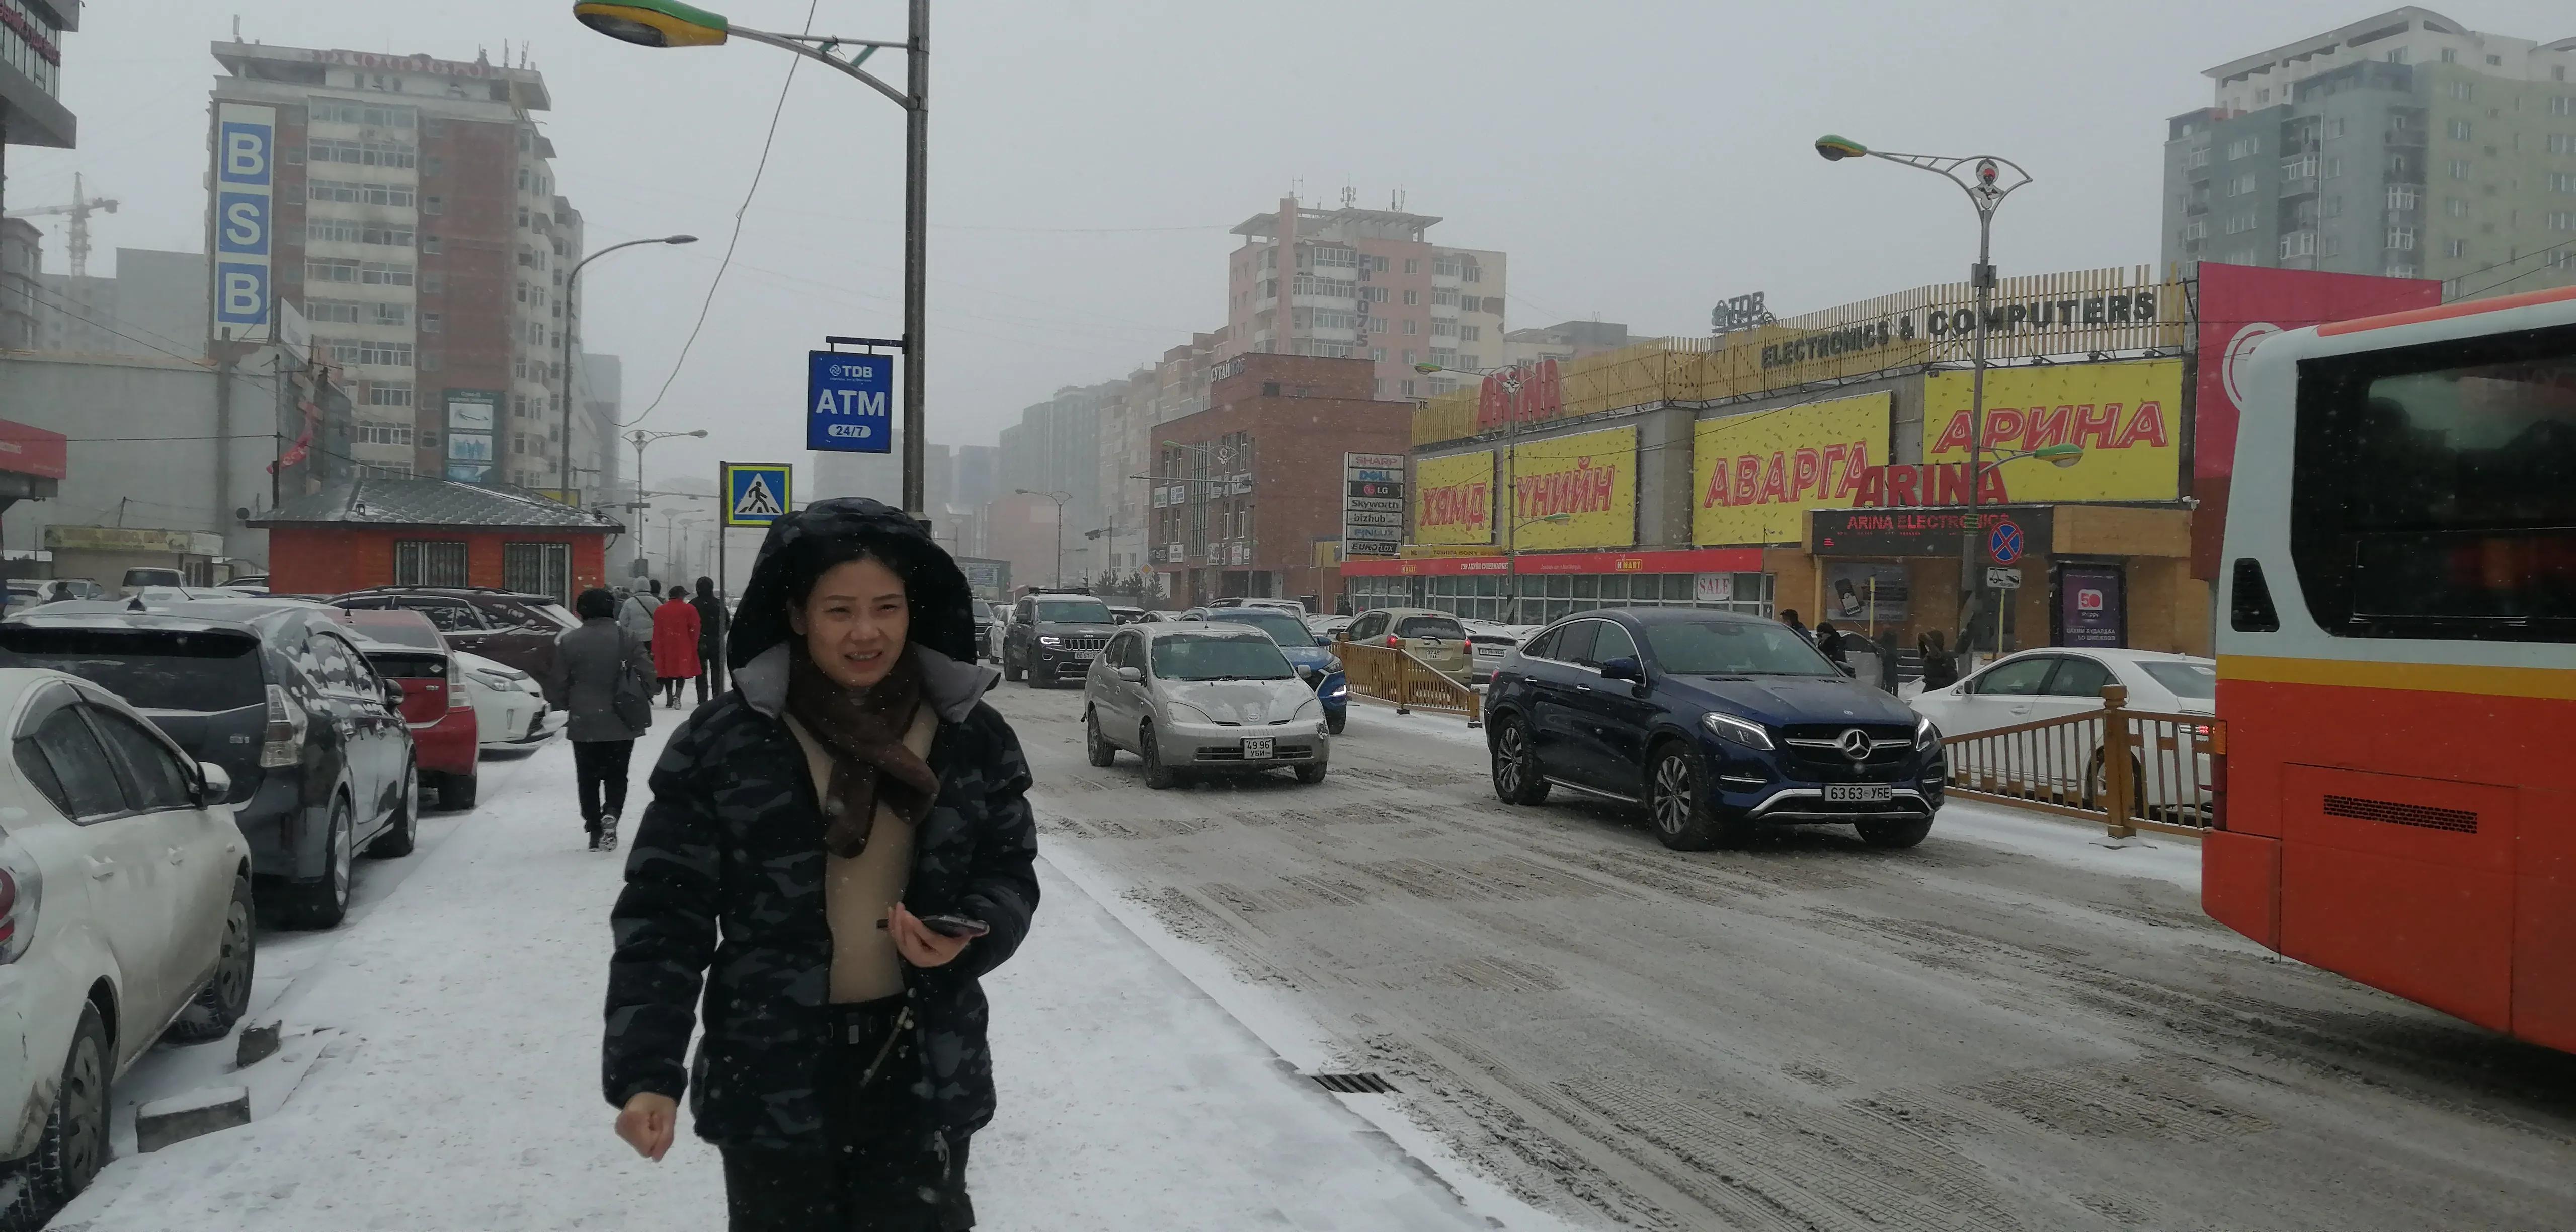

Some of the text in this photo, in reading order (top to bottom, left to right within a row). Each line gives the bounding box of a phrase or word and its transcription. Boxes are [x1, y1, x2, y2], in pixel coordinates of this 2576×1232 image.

[226, 132, 264, 314] BSB
[1729, 291, 1764, 319] TDB
[1762, 292, 2155, 369] ELECTRONICS & COMPUTERS
[842, 365, 873, 377] TDB
[816, 389, 885, 416] ATM
[836, 426, 863, 436] 24/7
[1931, 401, 2169, 454] АРИНА
[1356, 456, 1397, 465] SHARP
[1359, 470, 1392, 481] DELL
[1704, 441, 1869, 508] АВАРГА
[1853, 462, 2010, 507] ARINA
[1352, 500, 1399, 509] Skyworth
[1420, 482, 1486, 531] ХЯМД
[1354, 514, 1385, 522] bizhub
[1847, 515, 1894, 530] ARINA
[1354, 528, 1394, 537] FINLUX
[1699, 578, 1729, 594] SALE
[1871, 787, 1890, 799] УБЕ
